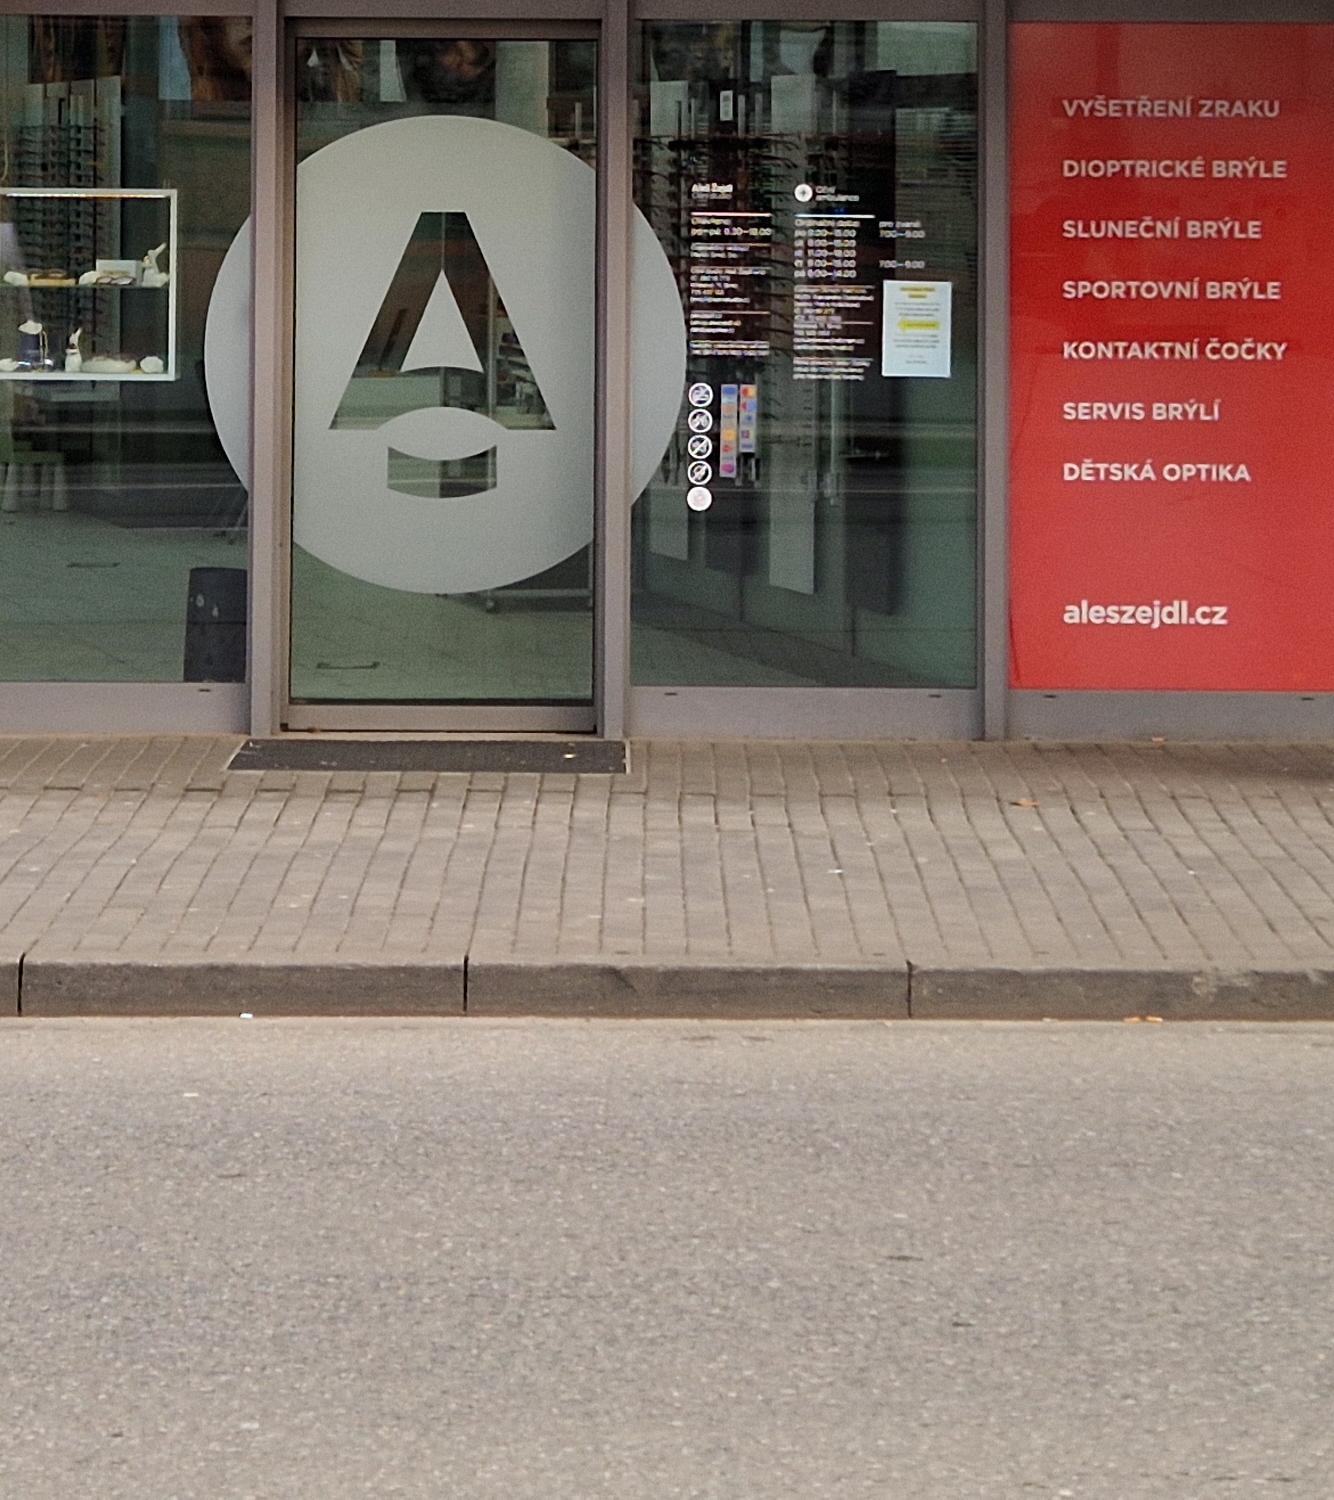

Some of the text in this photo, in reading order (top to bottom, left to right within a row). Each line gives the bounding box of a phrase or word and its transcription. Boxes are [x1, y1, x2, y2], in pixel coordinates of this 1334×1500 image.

[1062, 94, 1280, 118] VYŠETŘENÍ ZRAKU
[1062, 155, 1288, 179] DIOPTRICKÉ BRÝLE
[1062, 215, 1262, 239] SLUNEČNÍ BRÝLE
[1062, 277, 1282, 300] SPORTOVNÍ BRÝLE
[1063, 337, 1288, 361] KONTAKTNÍ ČOČKY
[1063, 398, 1221, 421] SERVIS BRÝLÍ
[1063, 458, 1252, 482] DĚTSKÁ OPTIKA
[1063, 599, 1228, 629] aleszejdl.cz
